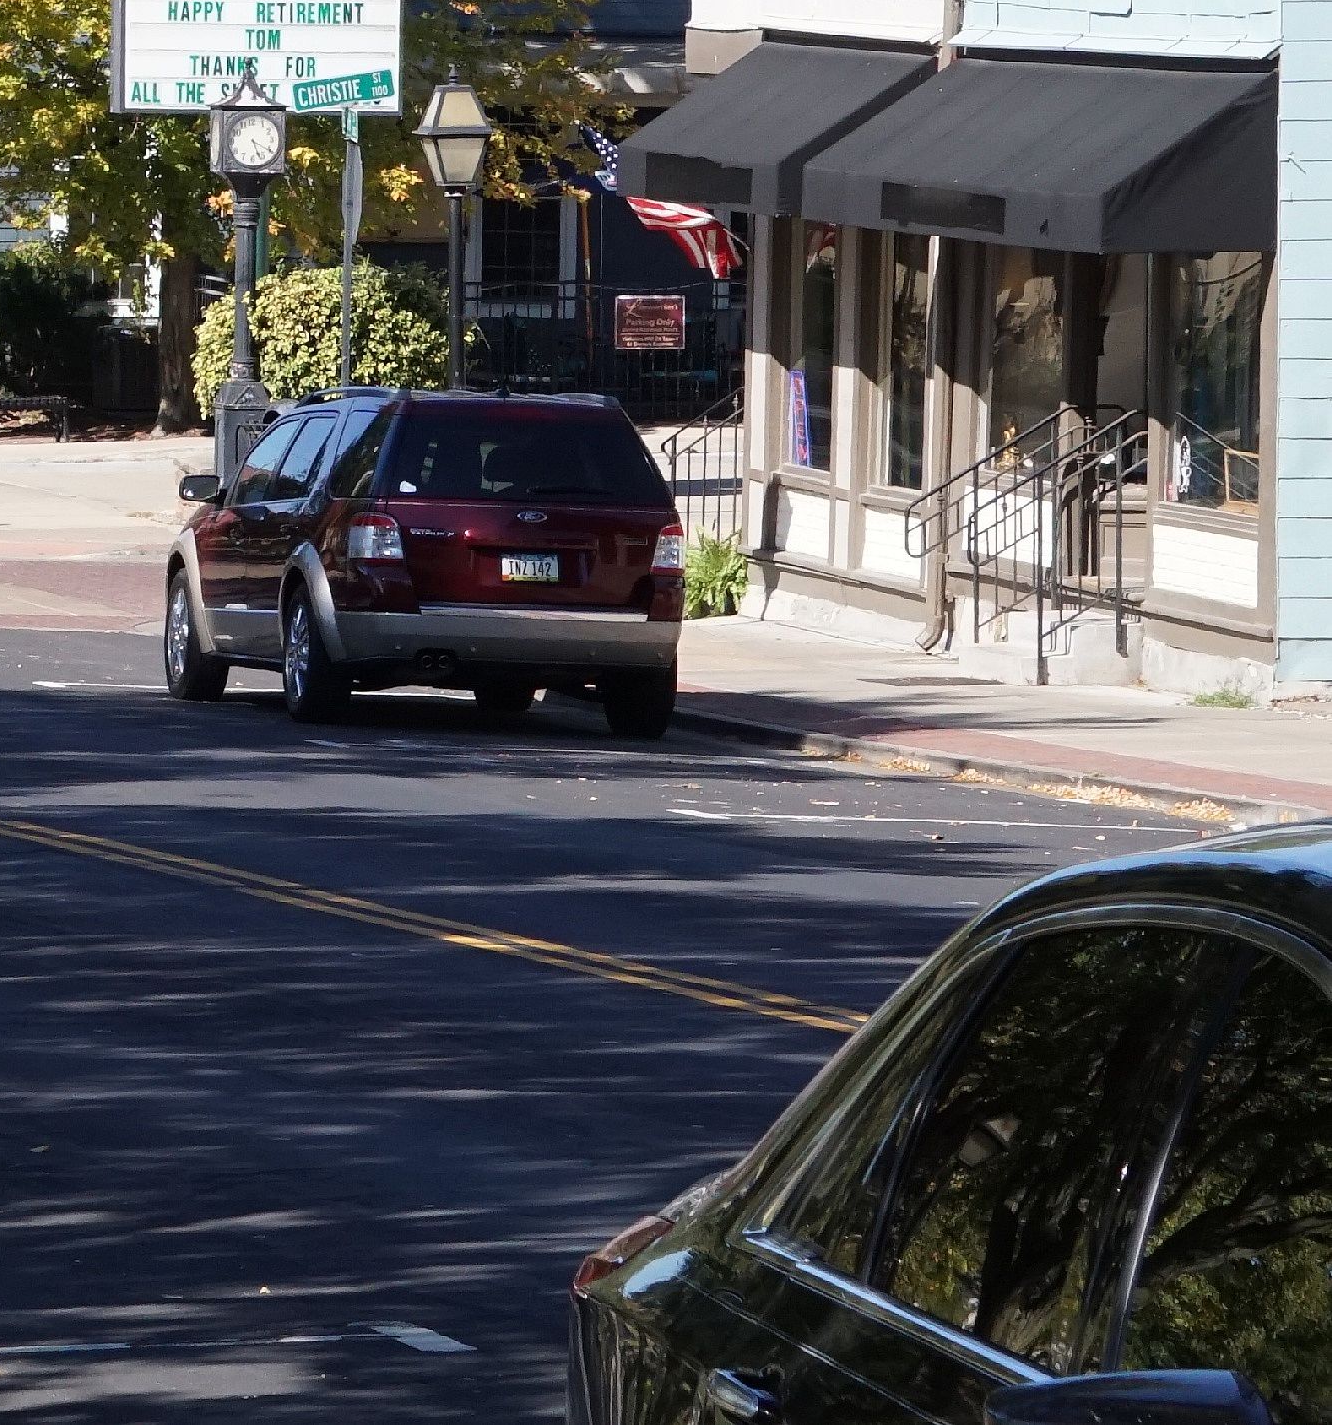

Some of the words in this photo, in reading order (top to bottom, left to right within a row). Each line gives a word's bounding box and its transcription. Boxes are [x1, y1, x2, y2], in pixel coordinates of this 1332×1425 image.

[167, 1, 224, 22] HAPPY
[256, 2, 364, 24] RETIREMENT
[245, 29, 282, 50] TOM
[286, 56, 316, 78] FOR
[131, 81, 161, 103] ALL
[175, 82, 206, 104] THE
[297, 79, 363, 107] CHRISTIE
[372, 72, 381, 84] ST
[532, 561, 552, 577] 142
